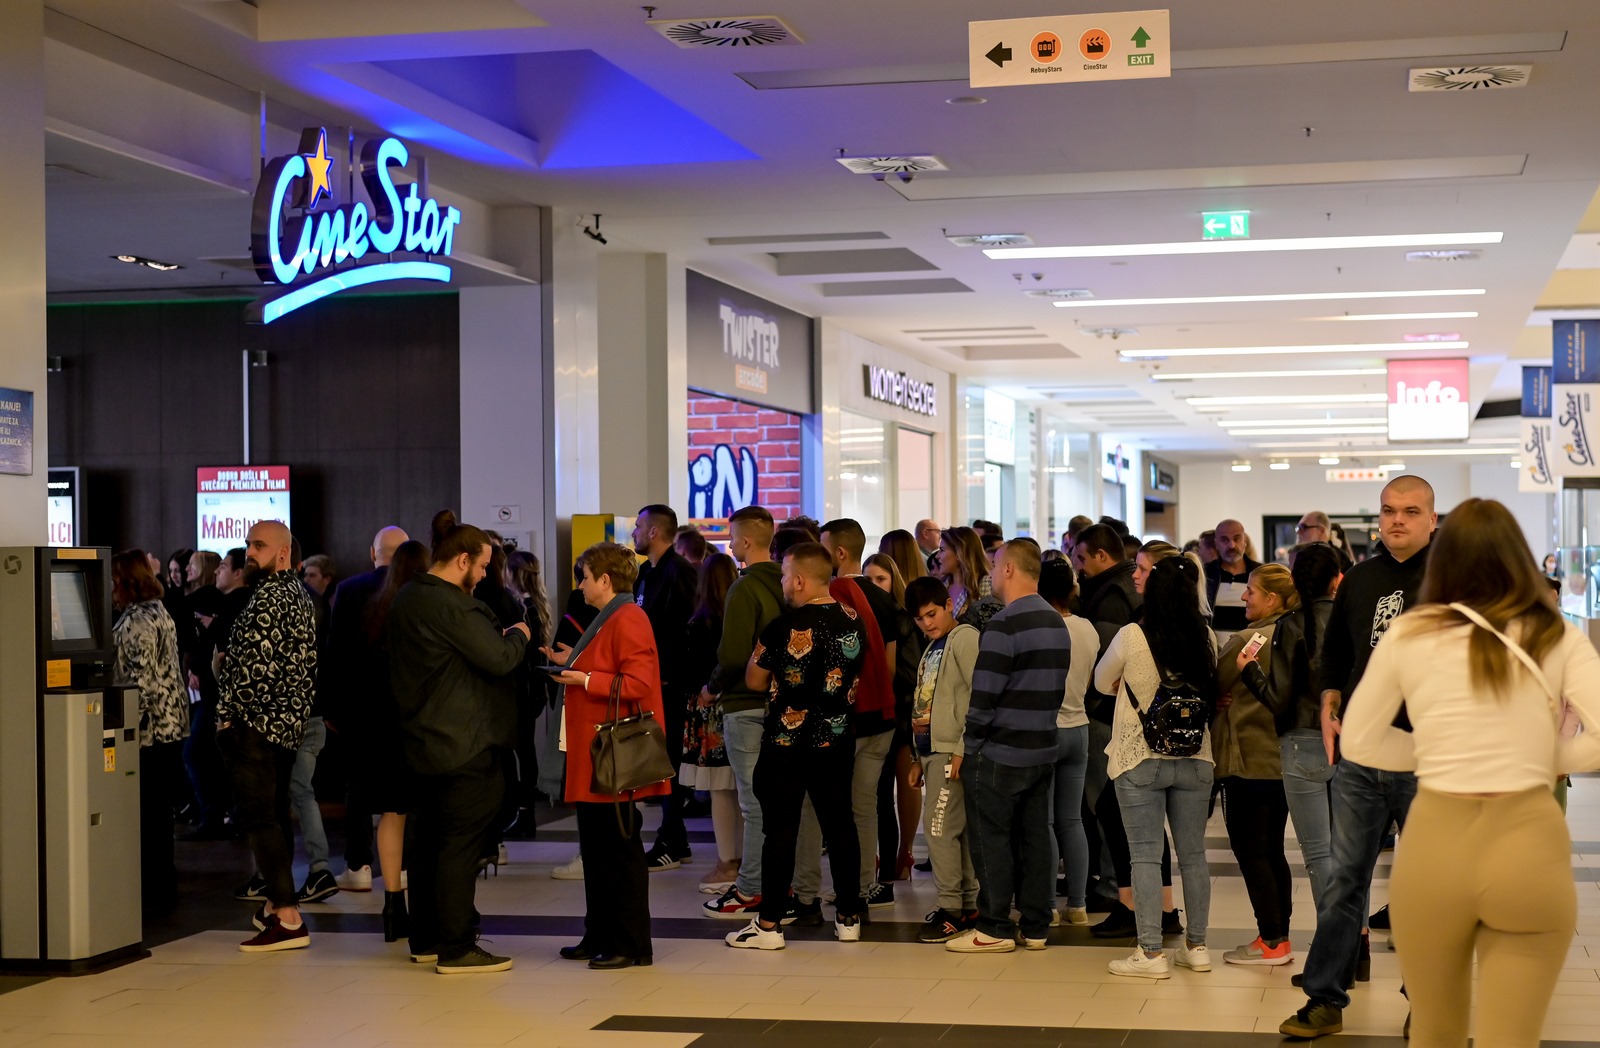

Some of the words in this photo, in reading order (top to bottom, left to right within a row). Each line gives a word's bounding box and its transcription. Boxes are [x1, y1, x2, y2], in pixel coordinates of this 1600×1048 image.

[1030, 66, 1062, 74] RebuyStars
[1131, 55, 1151, 64] EXIT
[269, 137, 461, 284] CineStar
[720, 304, 780, 369] TWISTER
